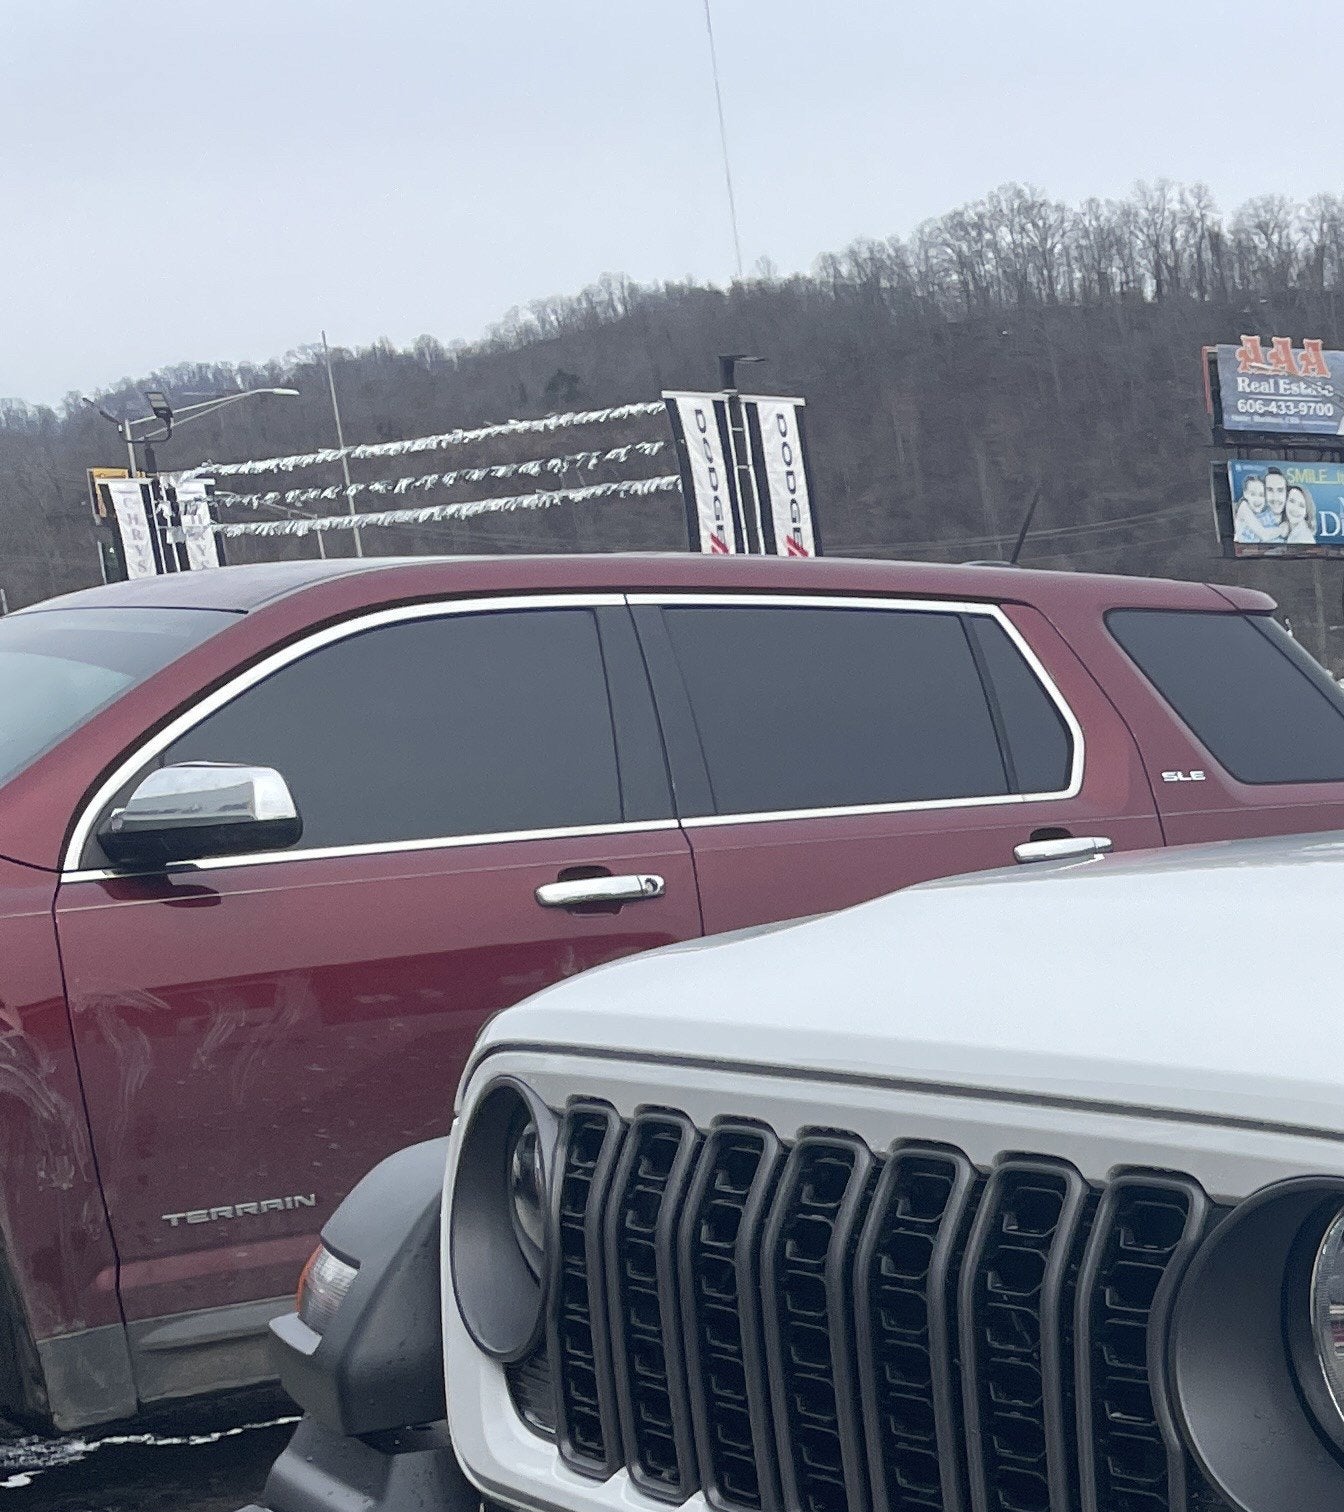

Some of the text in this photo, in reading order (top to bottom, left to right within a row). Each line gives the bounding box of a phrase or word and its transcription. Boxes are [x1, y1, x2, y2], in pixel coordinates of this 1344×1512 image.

[1235, 334, 1331, 378] AAA
[1236, 376, 1335, 397] Real Estate
[1236, 399, 1335, 416] 606-433-9700
[695, 409, 727, 545] DODGE
[776, 413, 804, 547] DODGE
[1161, 770, 1206, 782] SLE
[161, 1193, 317, 1227] TERRAIN
